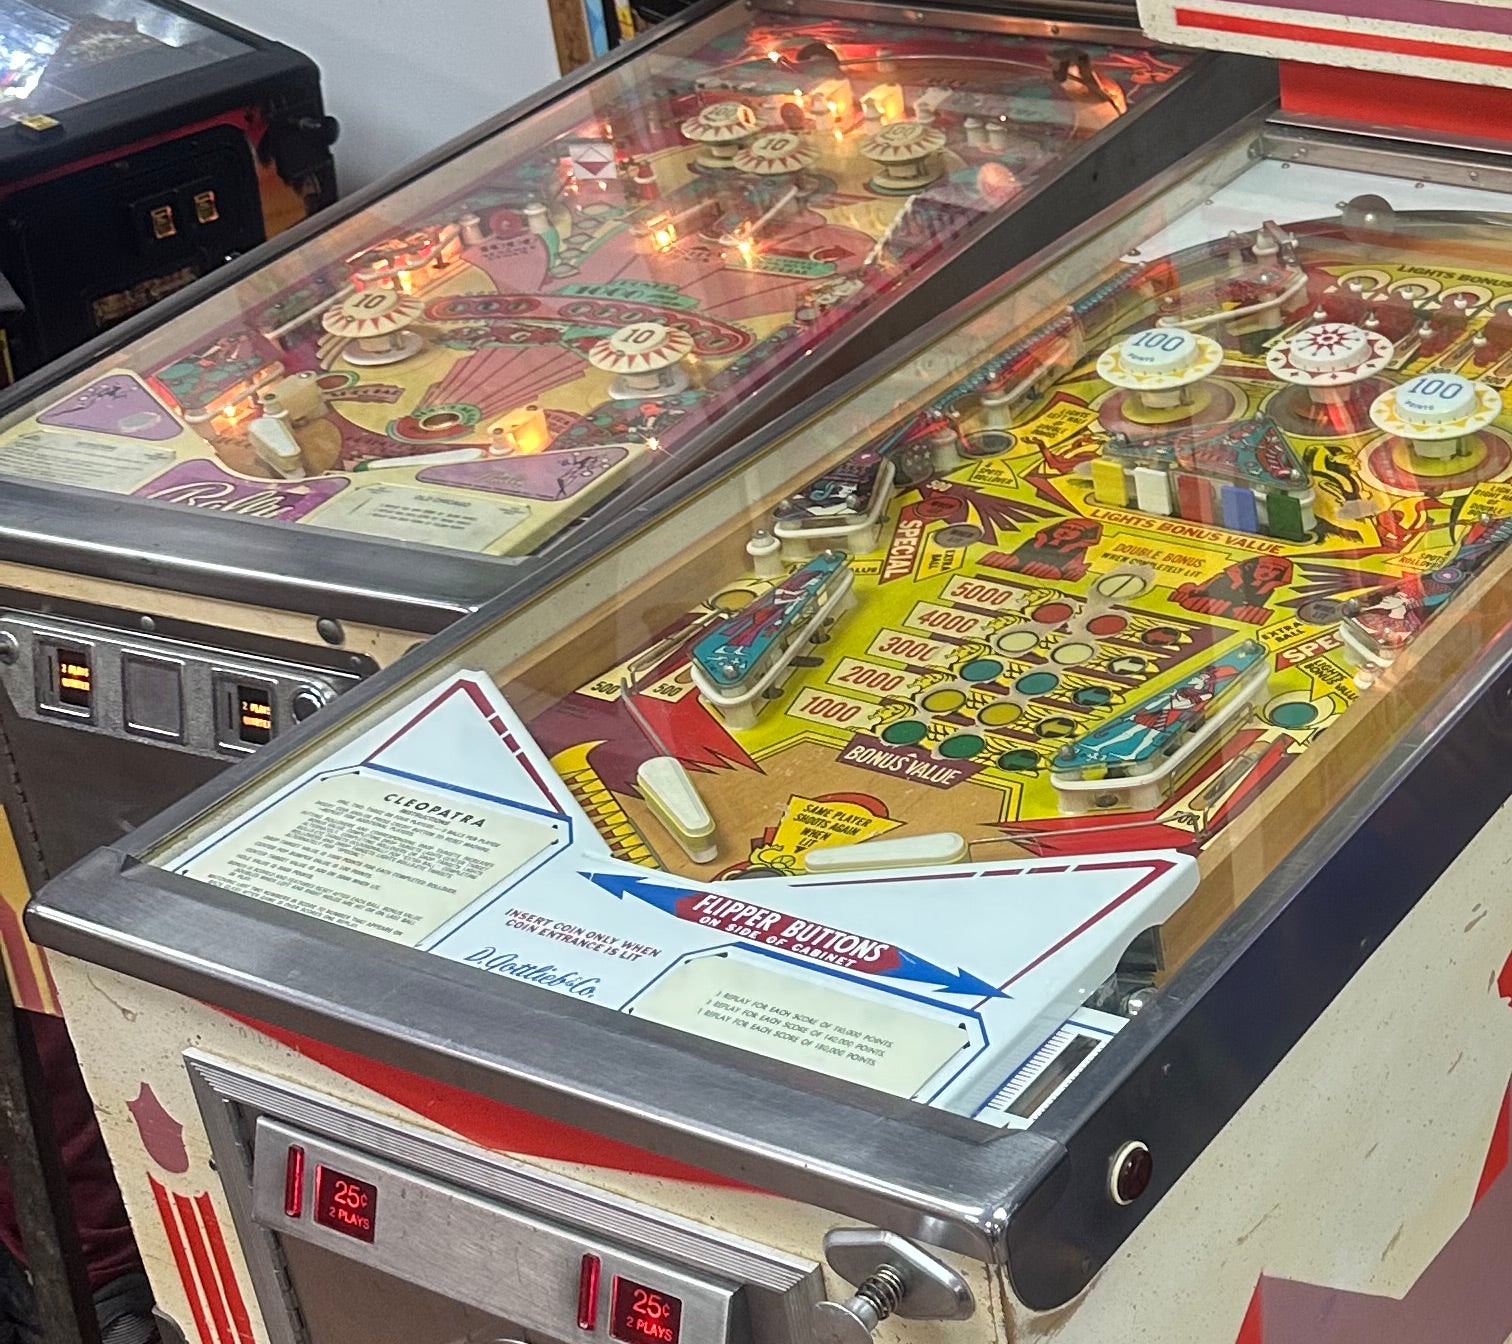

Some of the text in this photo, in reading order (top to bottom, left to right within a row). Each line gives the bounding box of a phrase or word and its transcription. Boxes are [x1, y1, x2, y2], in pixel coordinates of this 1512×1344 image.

[761, 135, 787, 152] 10
[1397, 265, 1451, 280] LIGHTS
[350, 292, 386, 311] 10
[620, 328, 655, 345] 10
[1133, 330, 1186, 353] 100
[1407, 377, 1465, 400] 100
[1089, 507, 1285, 555] LIGHTS BONUS VALUE
[883, 519, 924, 580] SPECIAL
[1112, 542, 1207, 569] DOUBLE BONUS
[1183, 567, 1202, 578] LIT
[950, 582, 1014, 605] 5000
[917, 608, 980, 634] 4000
[1260, 621, 1303, 642] EXTRA
[1273, 628, 1306, 643] BALL
[837, 666, 906, 693] 2000
[1306, 663, 1340, 687] BONUS
[1313, 658, 1348, 682] LIGHTS
[591, 681, 621, 695] 500
[652, 683, 684, 697] 500
[799, 695, 863, 723] 1000
[843, 744, 963, 786] BONUS VALUE
[383, 792, 487, 829] CLEOPATRA
[802, 802, 873, 828] SAME PLAYER
[793, 812, 863, 836] SHOOTS AGAIN
[801, 826, 833, 842] WHEN
[798, 837, 819, 848] LIT
[504, 907, 663, 958] INSERT COIN ONLY WHEN
[504, 917, 643, 963] COIN ENTRANCE IS LIT
[692, 894, 890, 963] FLIPPER BUTTONS
[698, 915, 858, 969] ON SIDE OF CABINET
[751, 999, 792, 1018] FOR EACH
[731, 1017, 749, 1028] FOR
[749, 1022, 773, 1036] EACH
[772, 1029, 801, 1044] SCORE
[741, 1007, 811, 1035] FOR EACH SCORE
[333, 1180, 369, 1209] 25¢
[328, 1206, 370, 1230] 2 PLAYS
[632, 1288, 671, 1319] 25¢
[625, 1316, 673, 1342] 2 PLAYS
